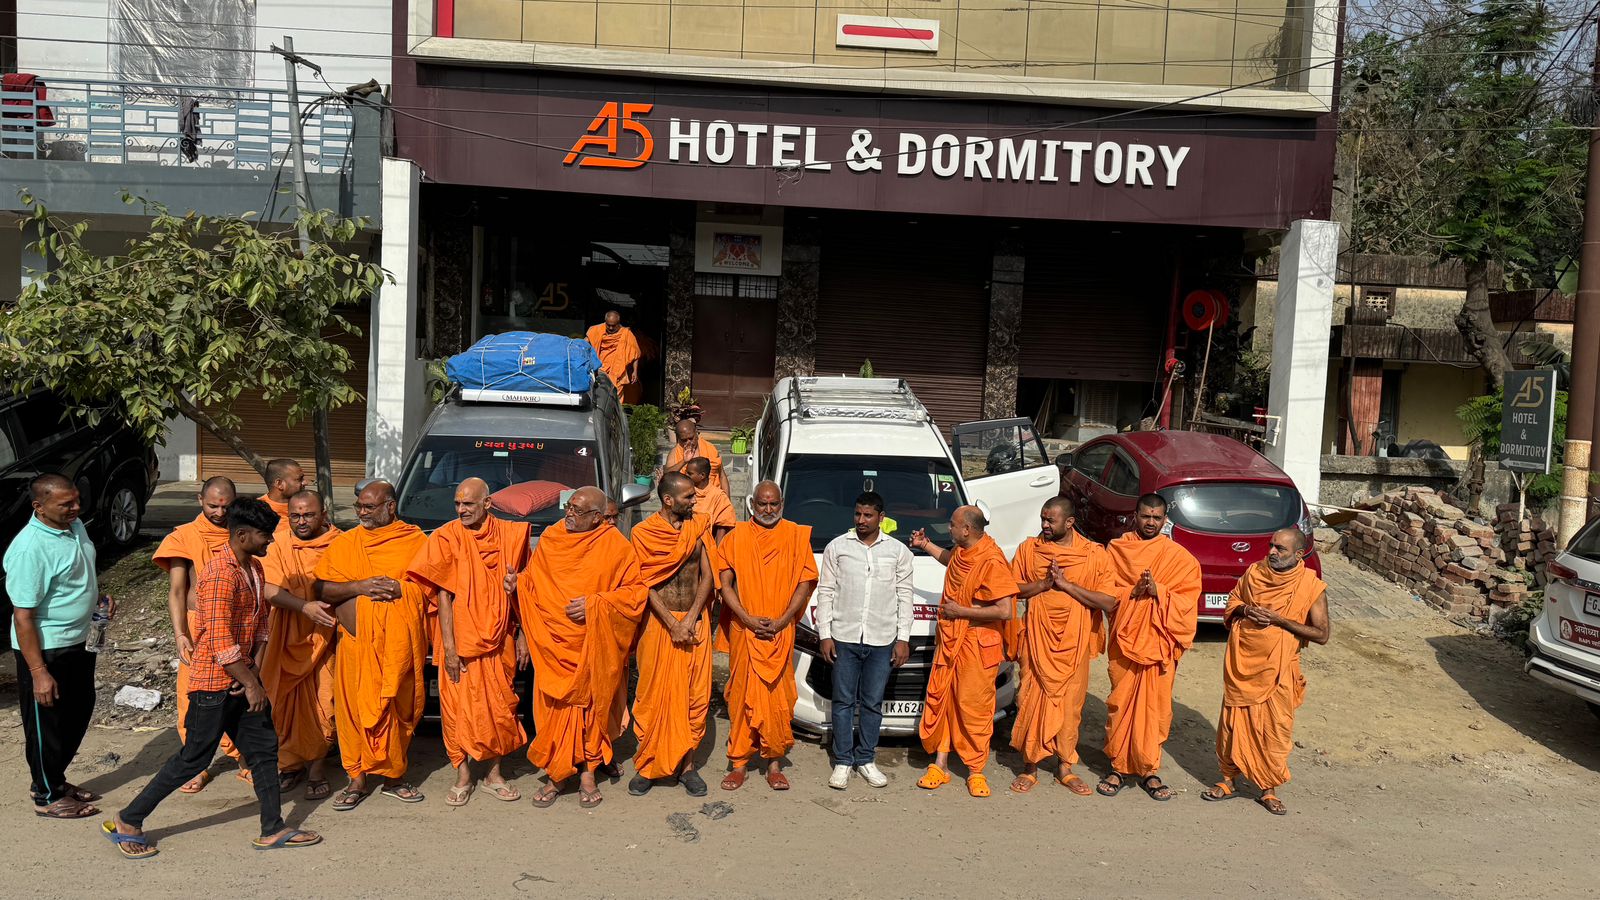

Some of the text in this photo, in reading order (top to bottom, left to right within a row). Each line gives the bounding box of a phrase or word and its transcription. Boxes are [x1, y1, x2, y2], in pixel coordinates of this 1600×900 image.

[562, 101, 1190, 187] A5 HOTEL & DORMITORY
[535, 282, 569, 310] A5
[504, 394, 538, 403] MAHAVIR
[1510, 376, 1545, 408] A5
[1512, 412, 1538, 425] HOTEL
[1520, 428, 1527, 441] &
[577, 447, 588, 457] 4
[1500, 443, 1547, 458] DORMITORY
[942, 482, 953, 492] 2
